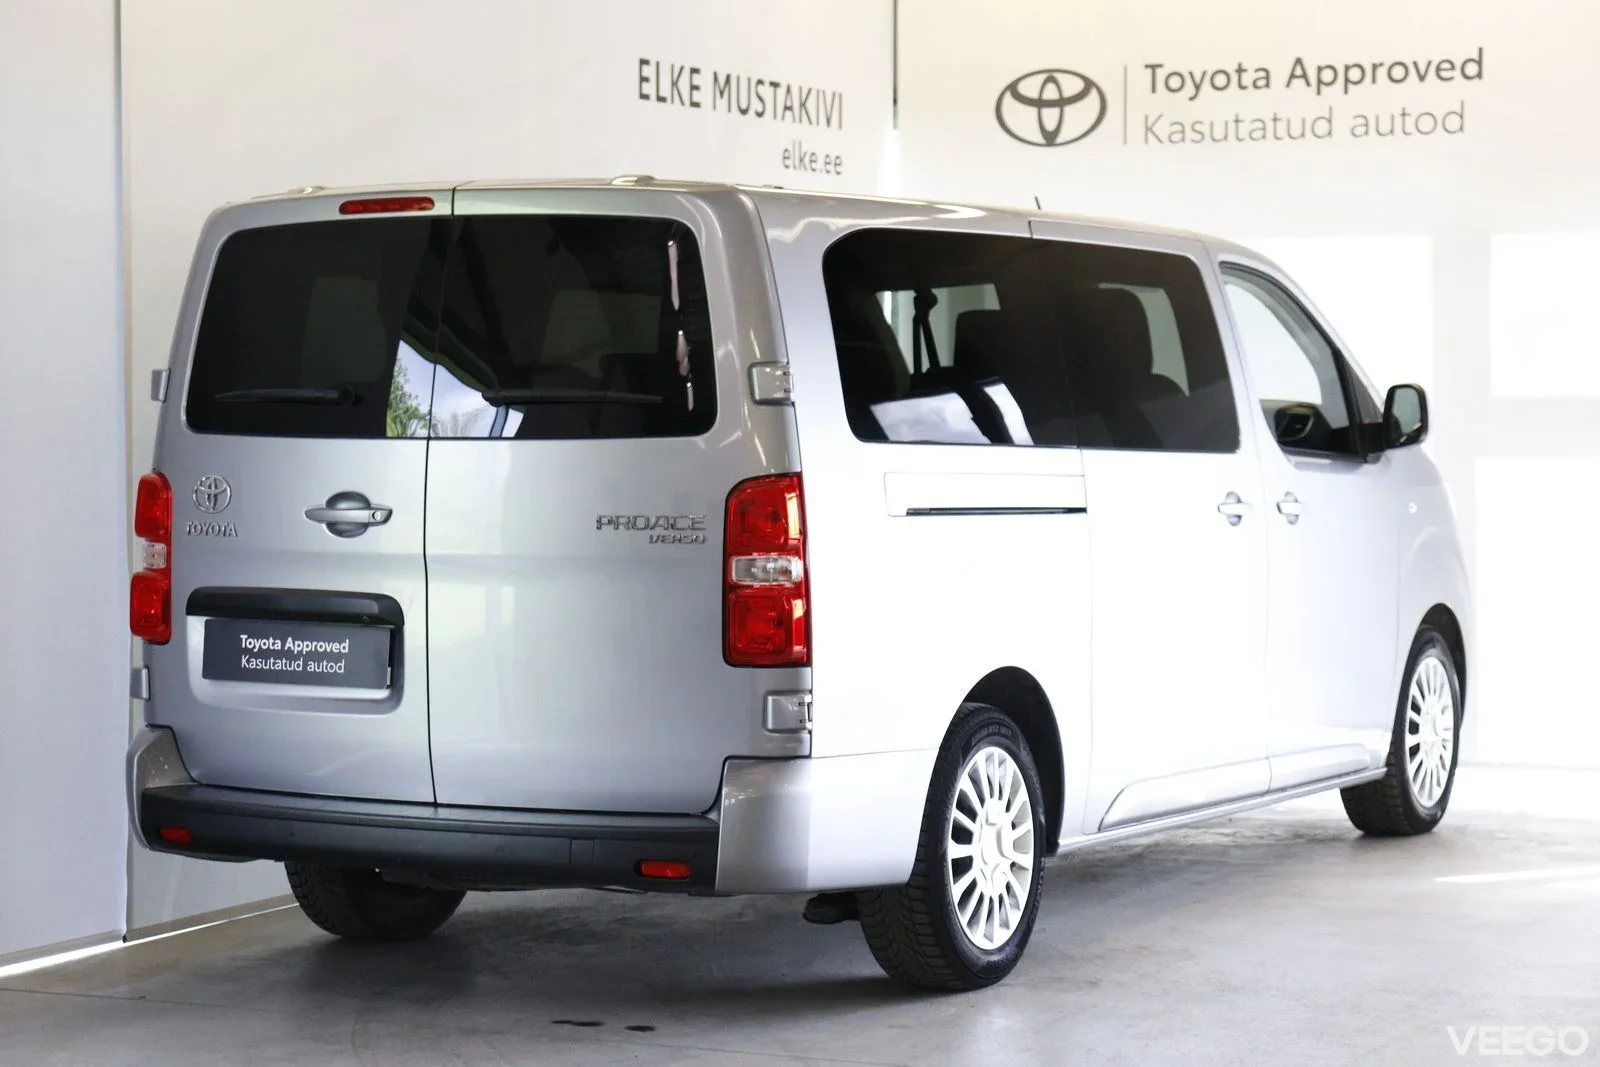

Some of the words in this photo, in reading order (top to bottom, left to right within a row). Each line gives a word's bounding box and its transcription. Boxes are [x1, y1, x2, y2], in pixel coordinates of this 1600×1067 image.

[1144, 63, 1272, 101] Toyota
[1285, 47, 1484, 96] Approved
[638, 57, 701, 108] ELKE
[713, 71, 843, 130] MUSTAKIVI
[1144, 105, 1333, 144] Kasutatud
[1350, 100, 1465, 138] autod
[782, 139, 843, 175] elke.ee
[186, 521, 238, 537] TOYOTA
[596, 515, 706, 531] PROACE
[648, 534, 706, 545] VERSO
[240, 634, 281, 652] Toyota
[285, 637, 349, 655] Approved
[241, 654, 303, 671] Kasutatud
[307, 659, 345, 674] autod
